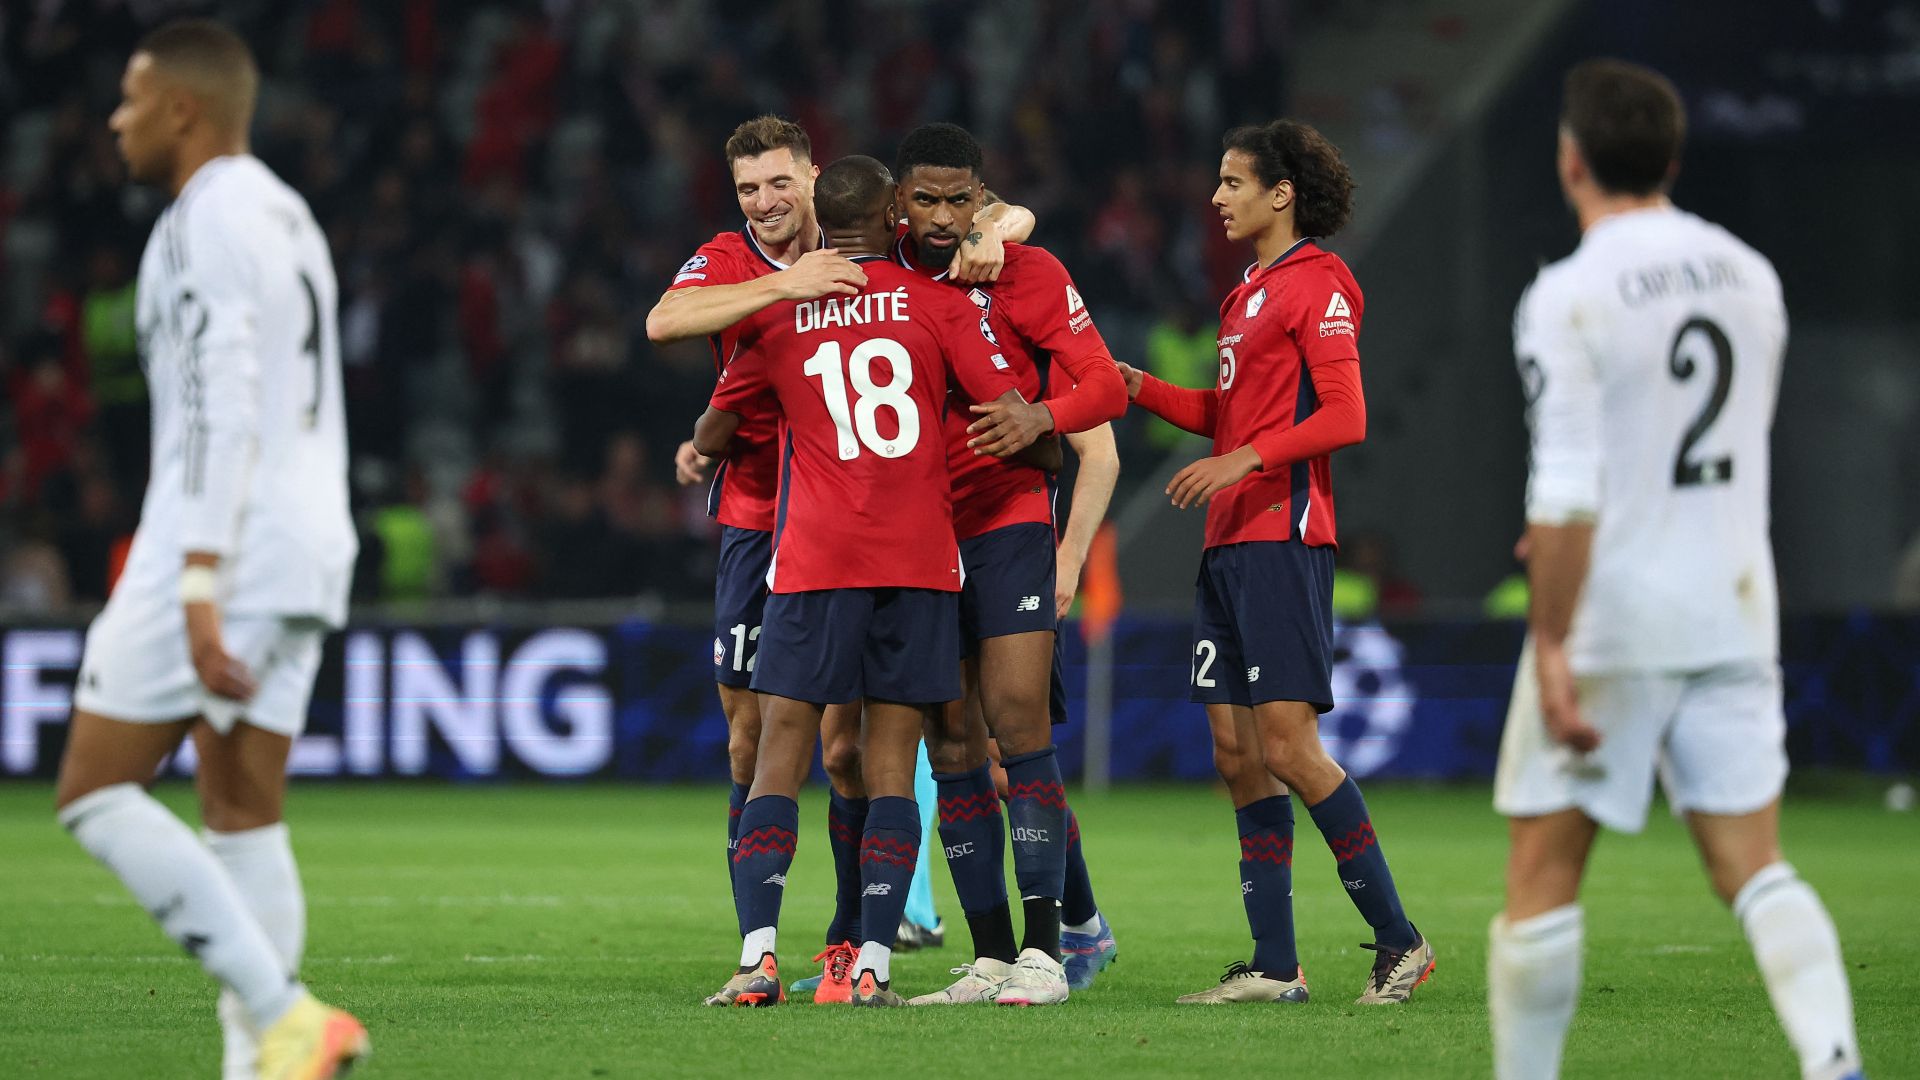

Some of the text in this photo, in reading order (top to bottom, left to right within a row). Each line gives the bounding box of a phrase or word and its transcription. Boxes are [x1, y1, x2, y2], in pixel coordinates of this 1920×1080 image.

[796, 286, 910, 333] DIAKITÉ
[804, 338, 920, 460] 18
[1670, 316, 1733, 488] 2
[1191, 640, 1217, 687] 2
[946, 842, 975, 859] OSC
[1012, 827, 1050, 842] LOSC
[1241, 881, 1253, 894] SC
[1343, 879, 1366, 890] OSC
